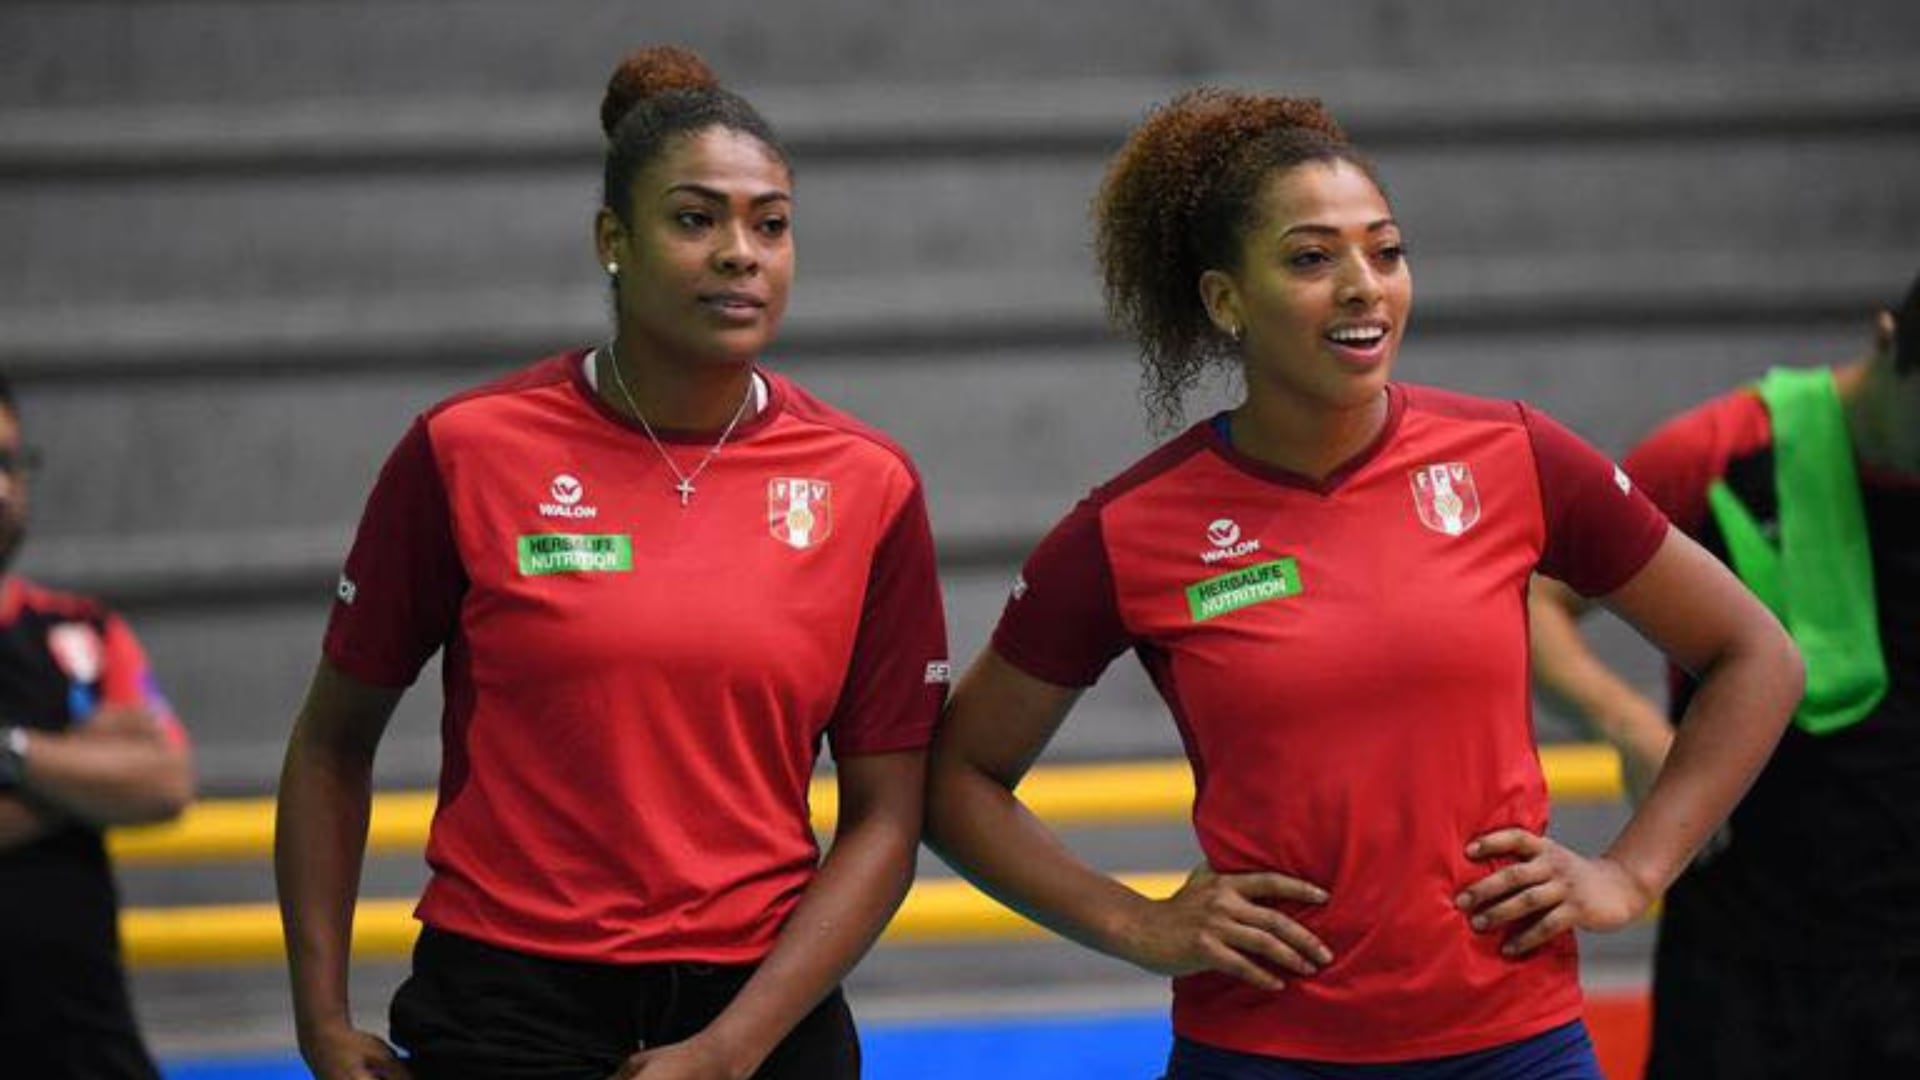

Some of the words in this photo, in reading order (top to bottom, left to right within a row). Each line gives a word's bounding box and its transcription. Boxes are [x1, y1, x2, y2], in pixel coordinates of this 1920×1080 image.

[539, 503, 597, 518] WALON
[1200, 539, 1260, 563] WALON
[1199, 565, 1283, 600] HERBALIFE
[1200, 578, 1286, 616] NUTRITION
